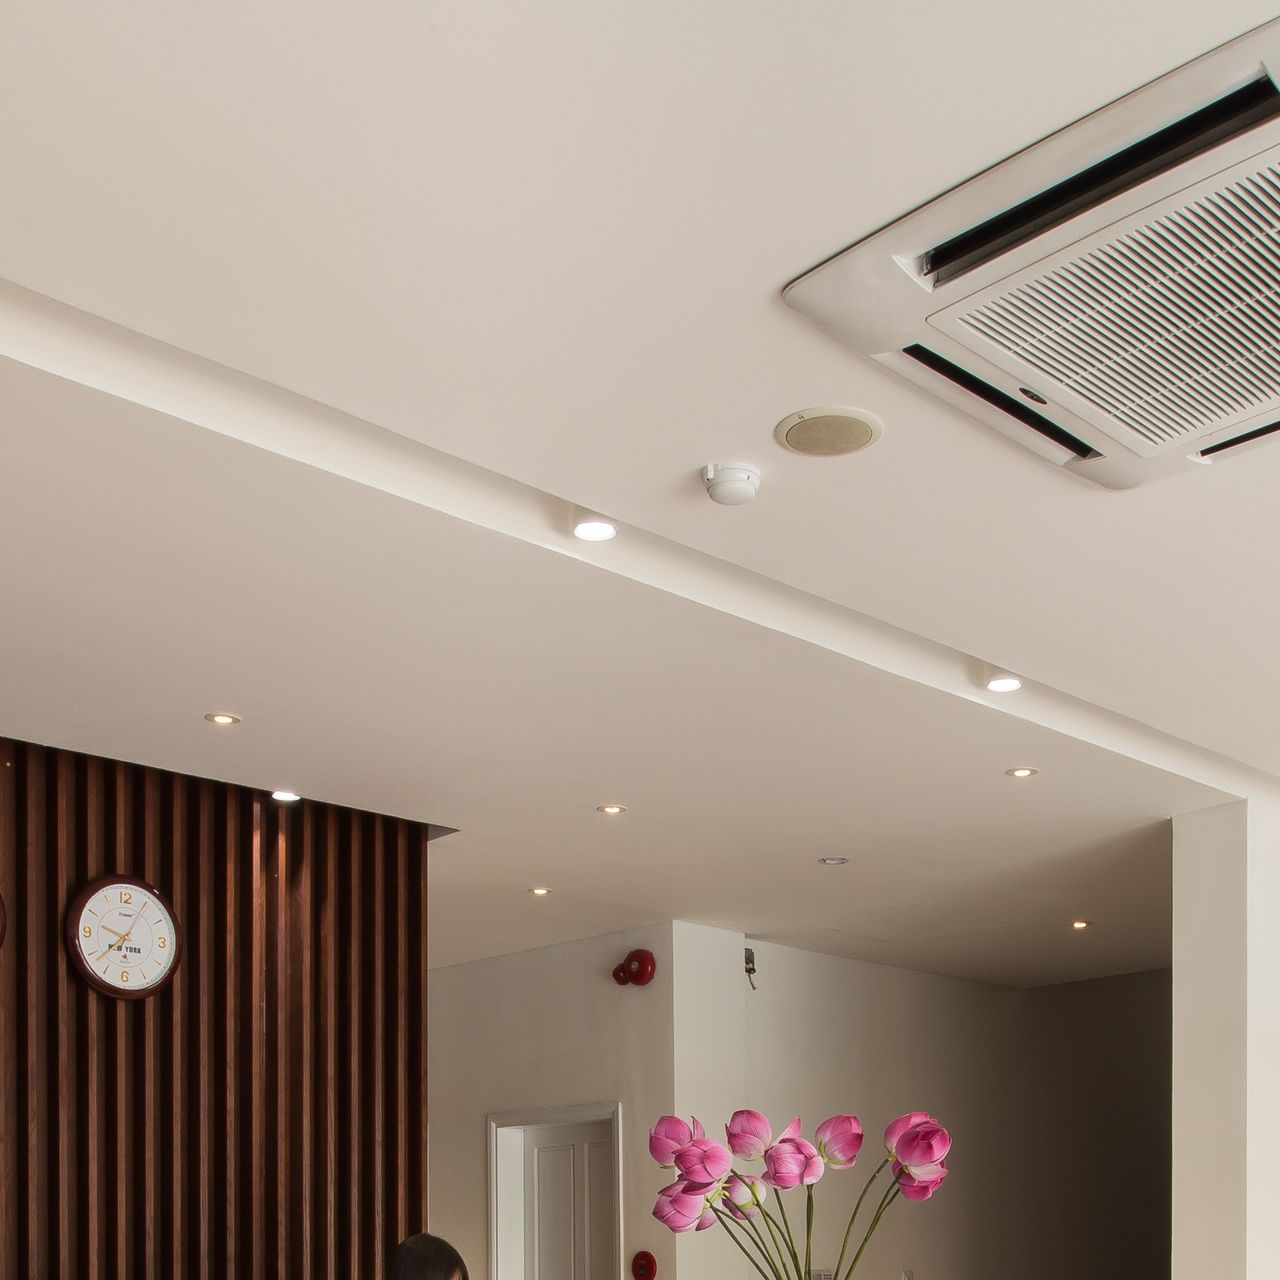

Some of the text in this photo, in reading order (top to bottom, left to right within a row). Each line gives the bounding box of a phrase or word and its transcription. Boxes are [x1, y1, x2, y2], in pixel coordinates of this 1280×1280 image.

[119, 891, 132, 905] 12
[83, 926, 92, 939] 9
[158, 936, 167, 949] 3
[125, 945, 142, 954] YORK
[120, 970, 130, 983] 6
